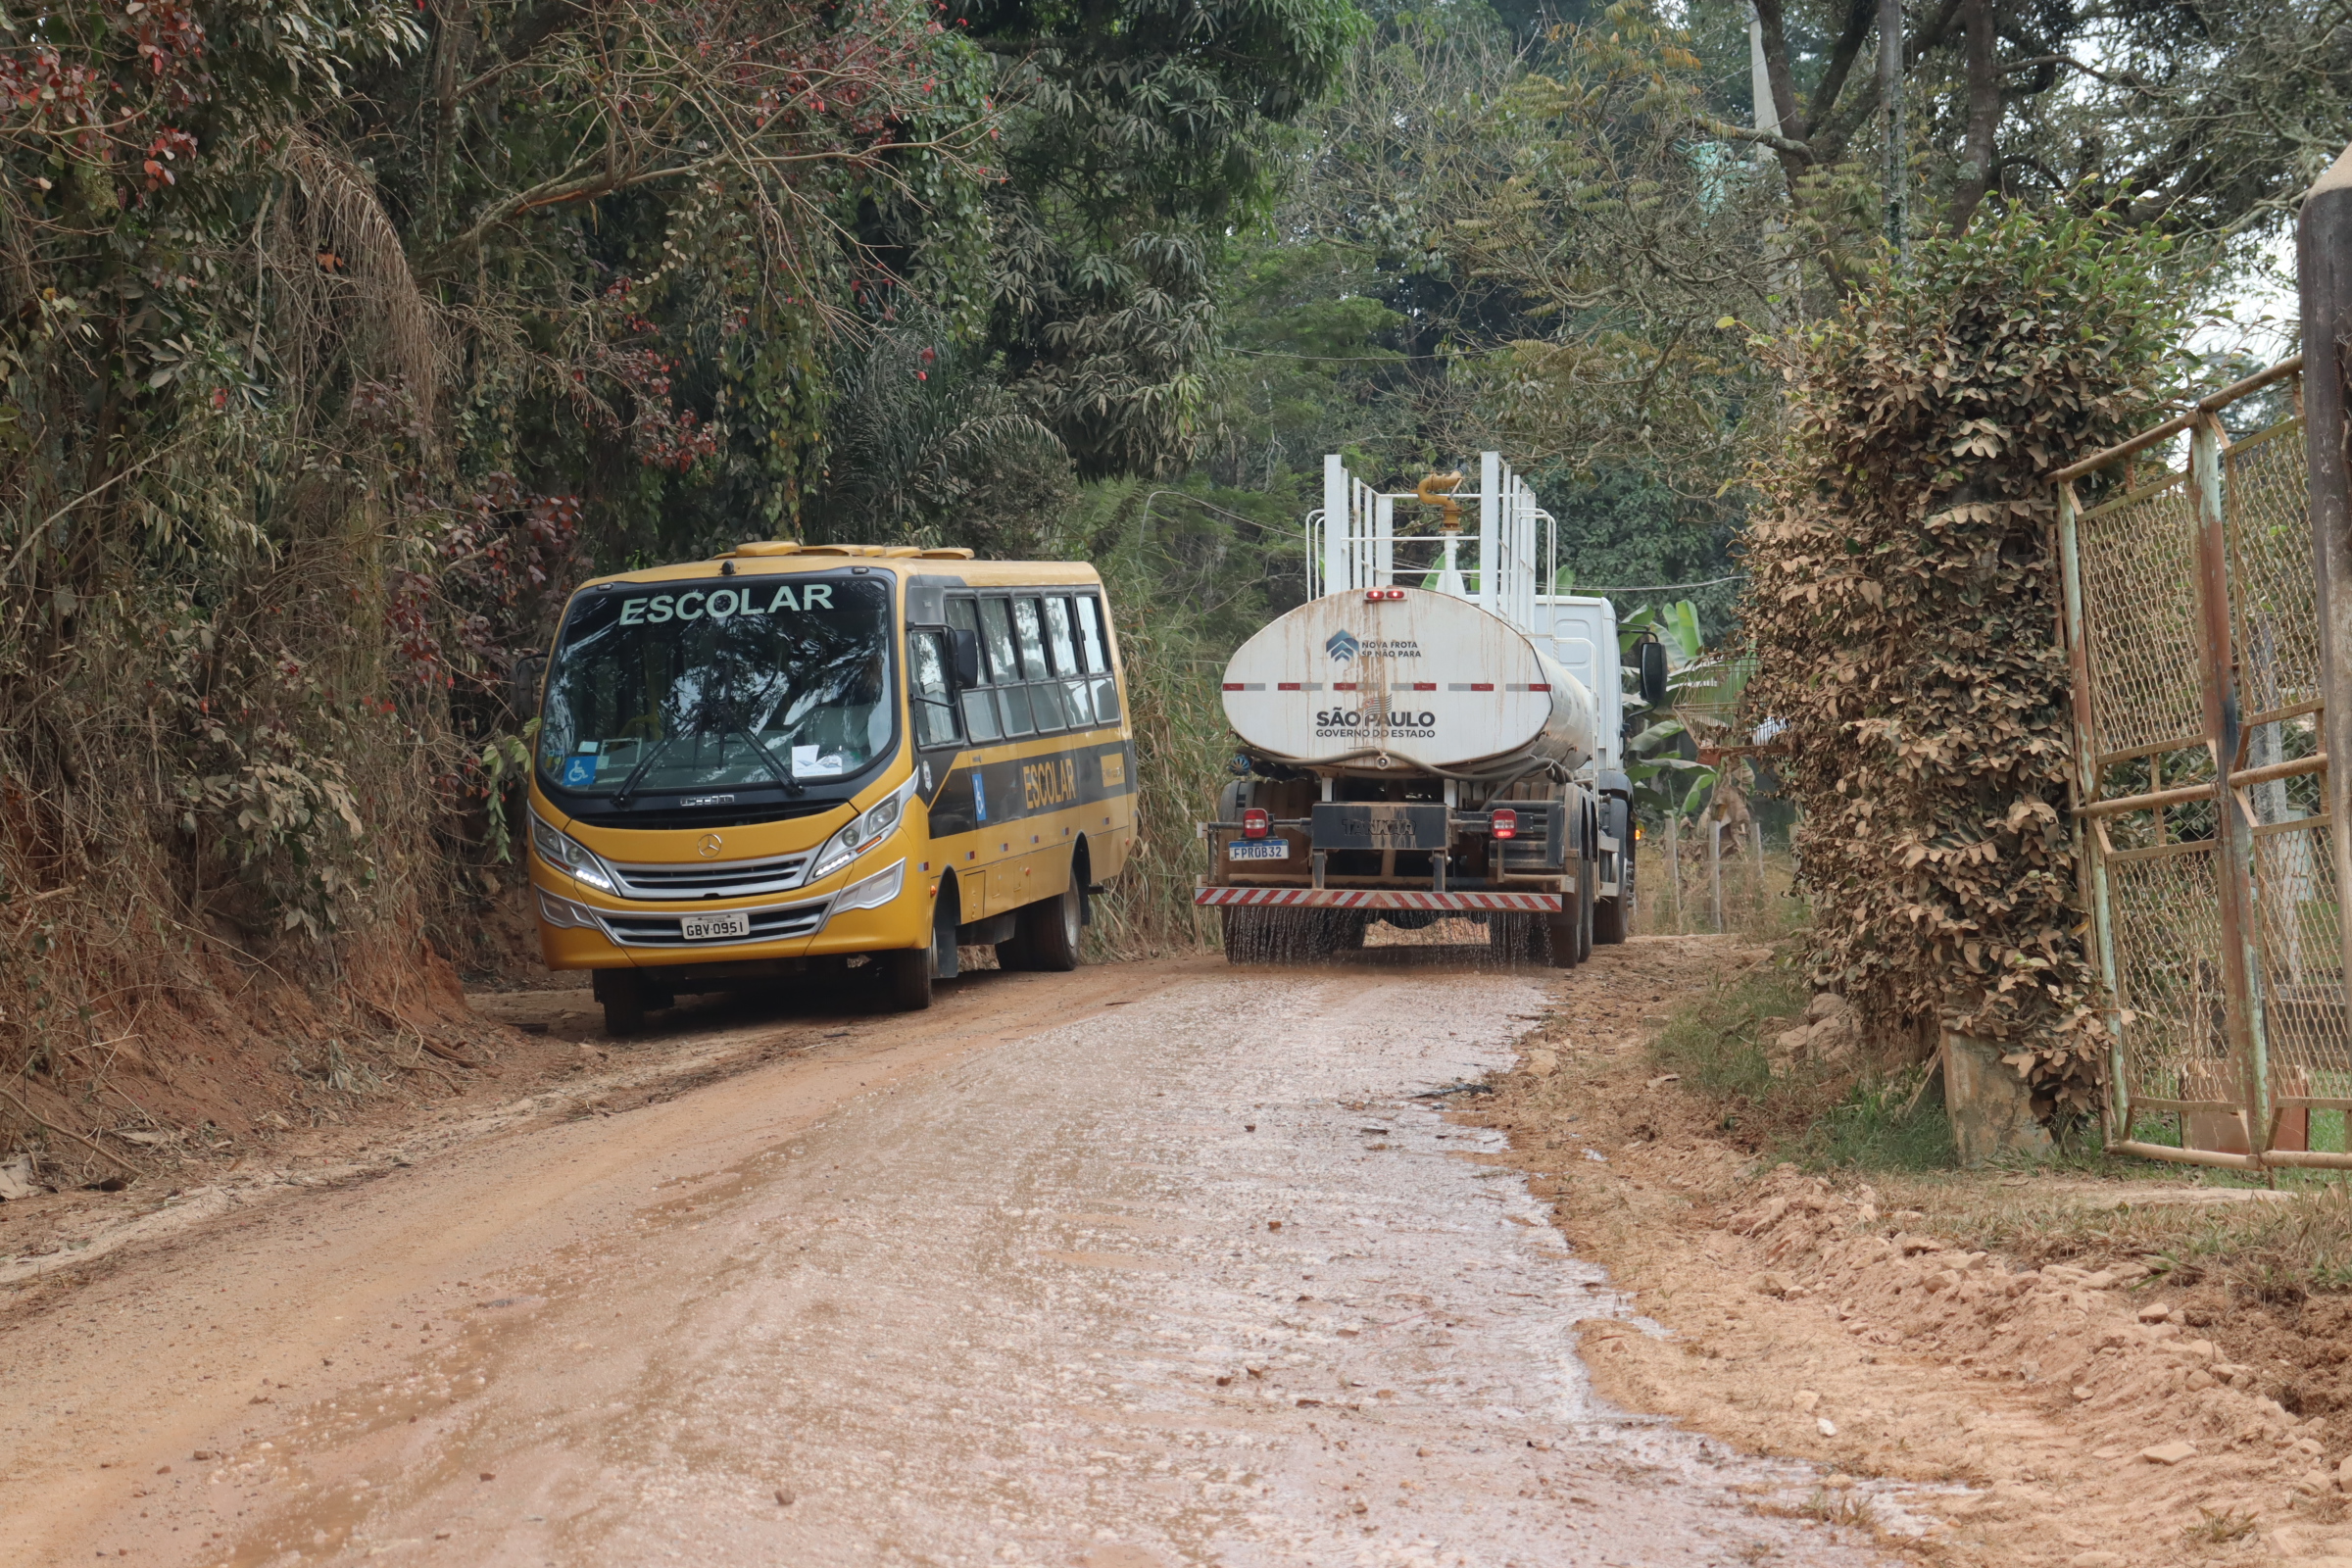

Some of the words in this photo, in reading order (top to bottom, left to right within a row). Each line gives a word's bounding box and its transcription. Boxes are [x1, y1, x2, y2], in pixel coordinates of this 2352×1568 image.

[619, 584, 834, 626] ESCOLAR
[1374, 648, 1396, 658] NÃO
[1316, 707, 1361, 727] SÃO
[1364, 711, 1436, 727] PAULO
[1315, 728, 1371, 738] GOVERNO
[1372, 729, 1390, 738] DO
[1391, 729, 1436, 738] ESTADO
[1022, 758, 1077, 809] ESCOLAR
